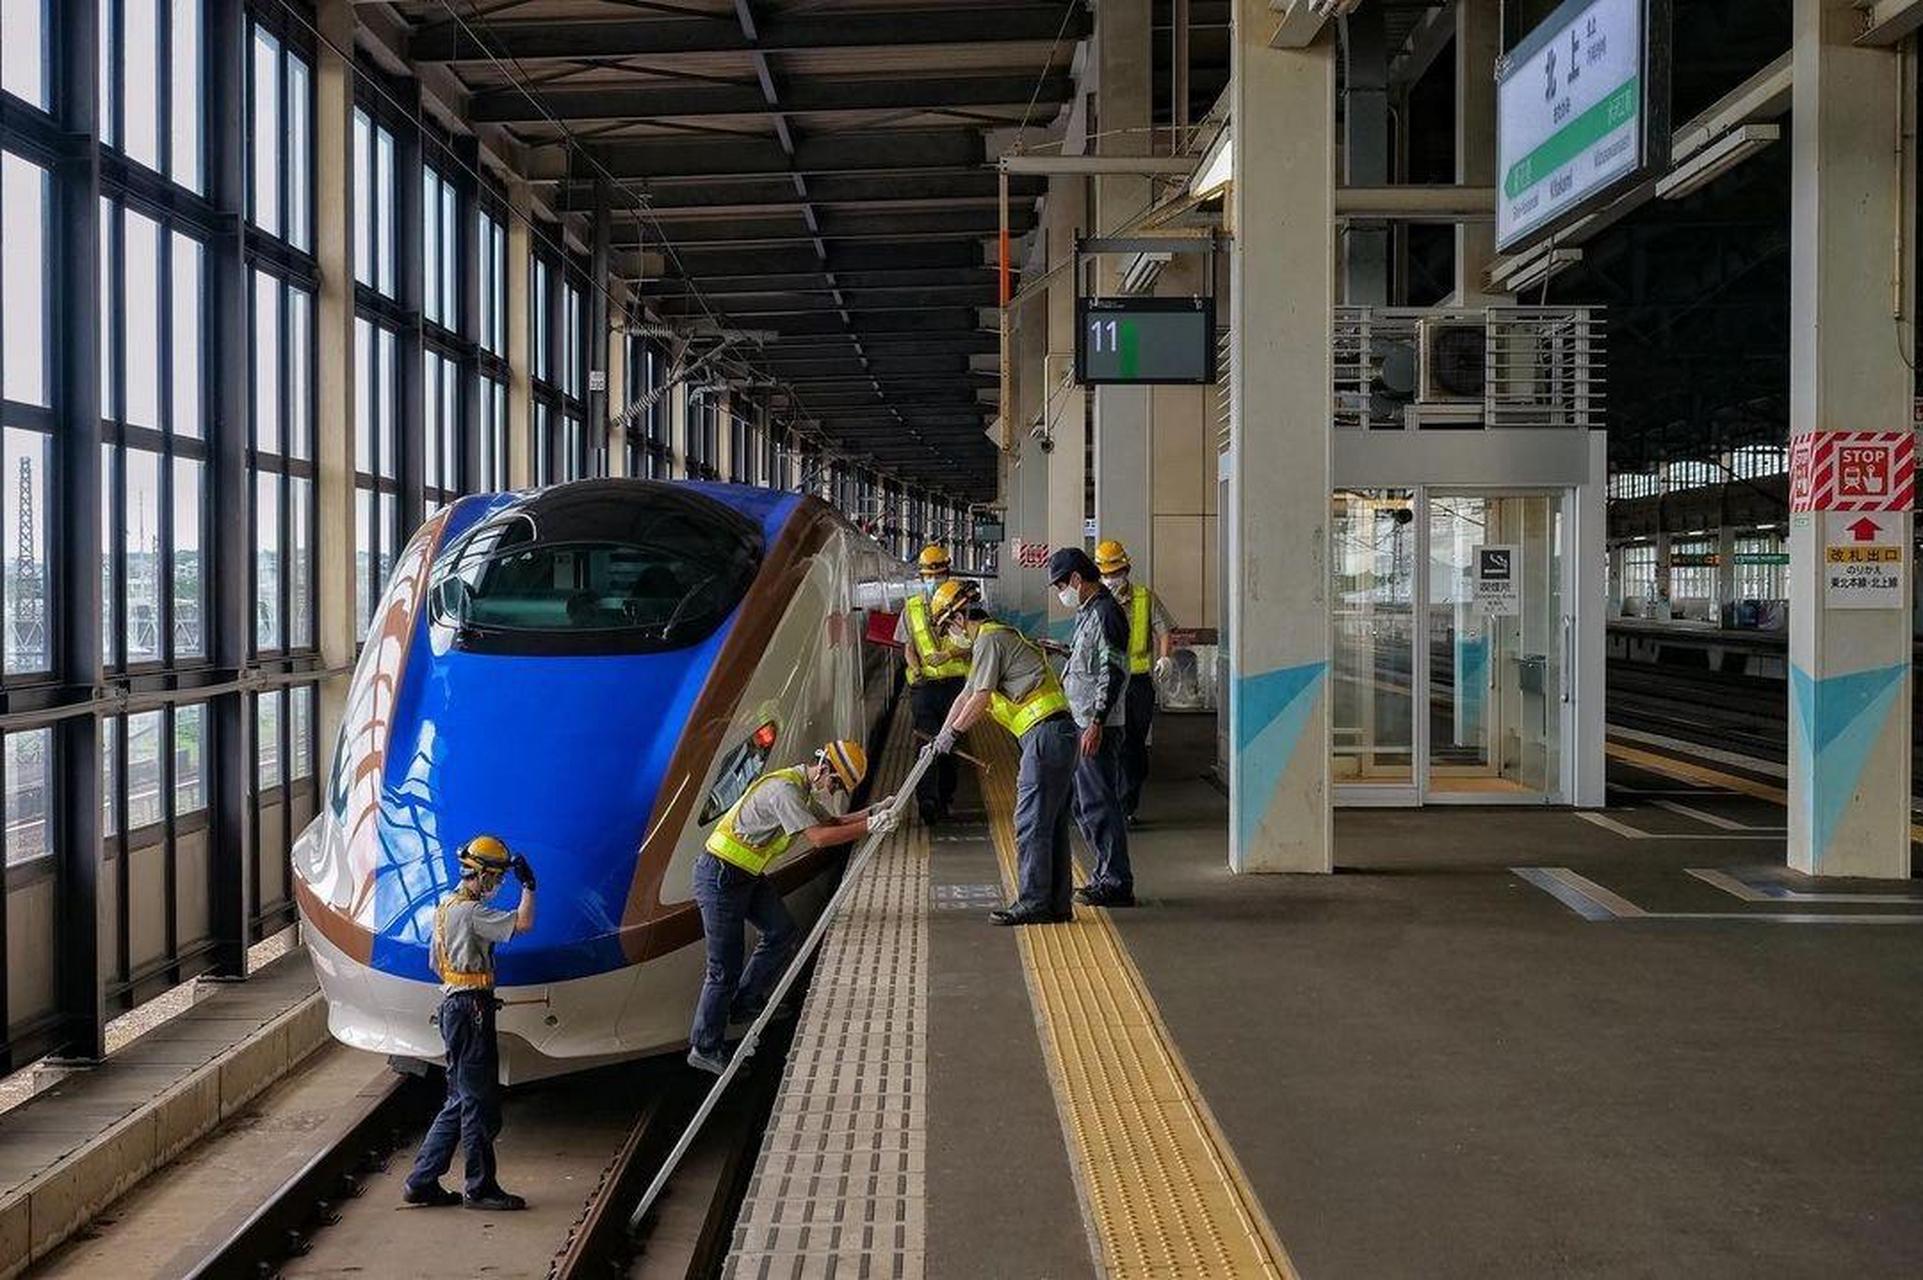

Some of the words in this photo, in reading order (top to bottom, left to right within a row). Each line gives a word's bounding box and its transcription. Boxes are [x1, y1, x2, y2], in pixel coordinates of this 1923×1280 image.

[1091, 320, 1117, 352] 11
[1842, 449, 1885, 463] STOP
[1831, 549, 1898, 563] 改札出口
